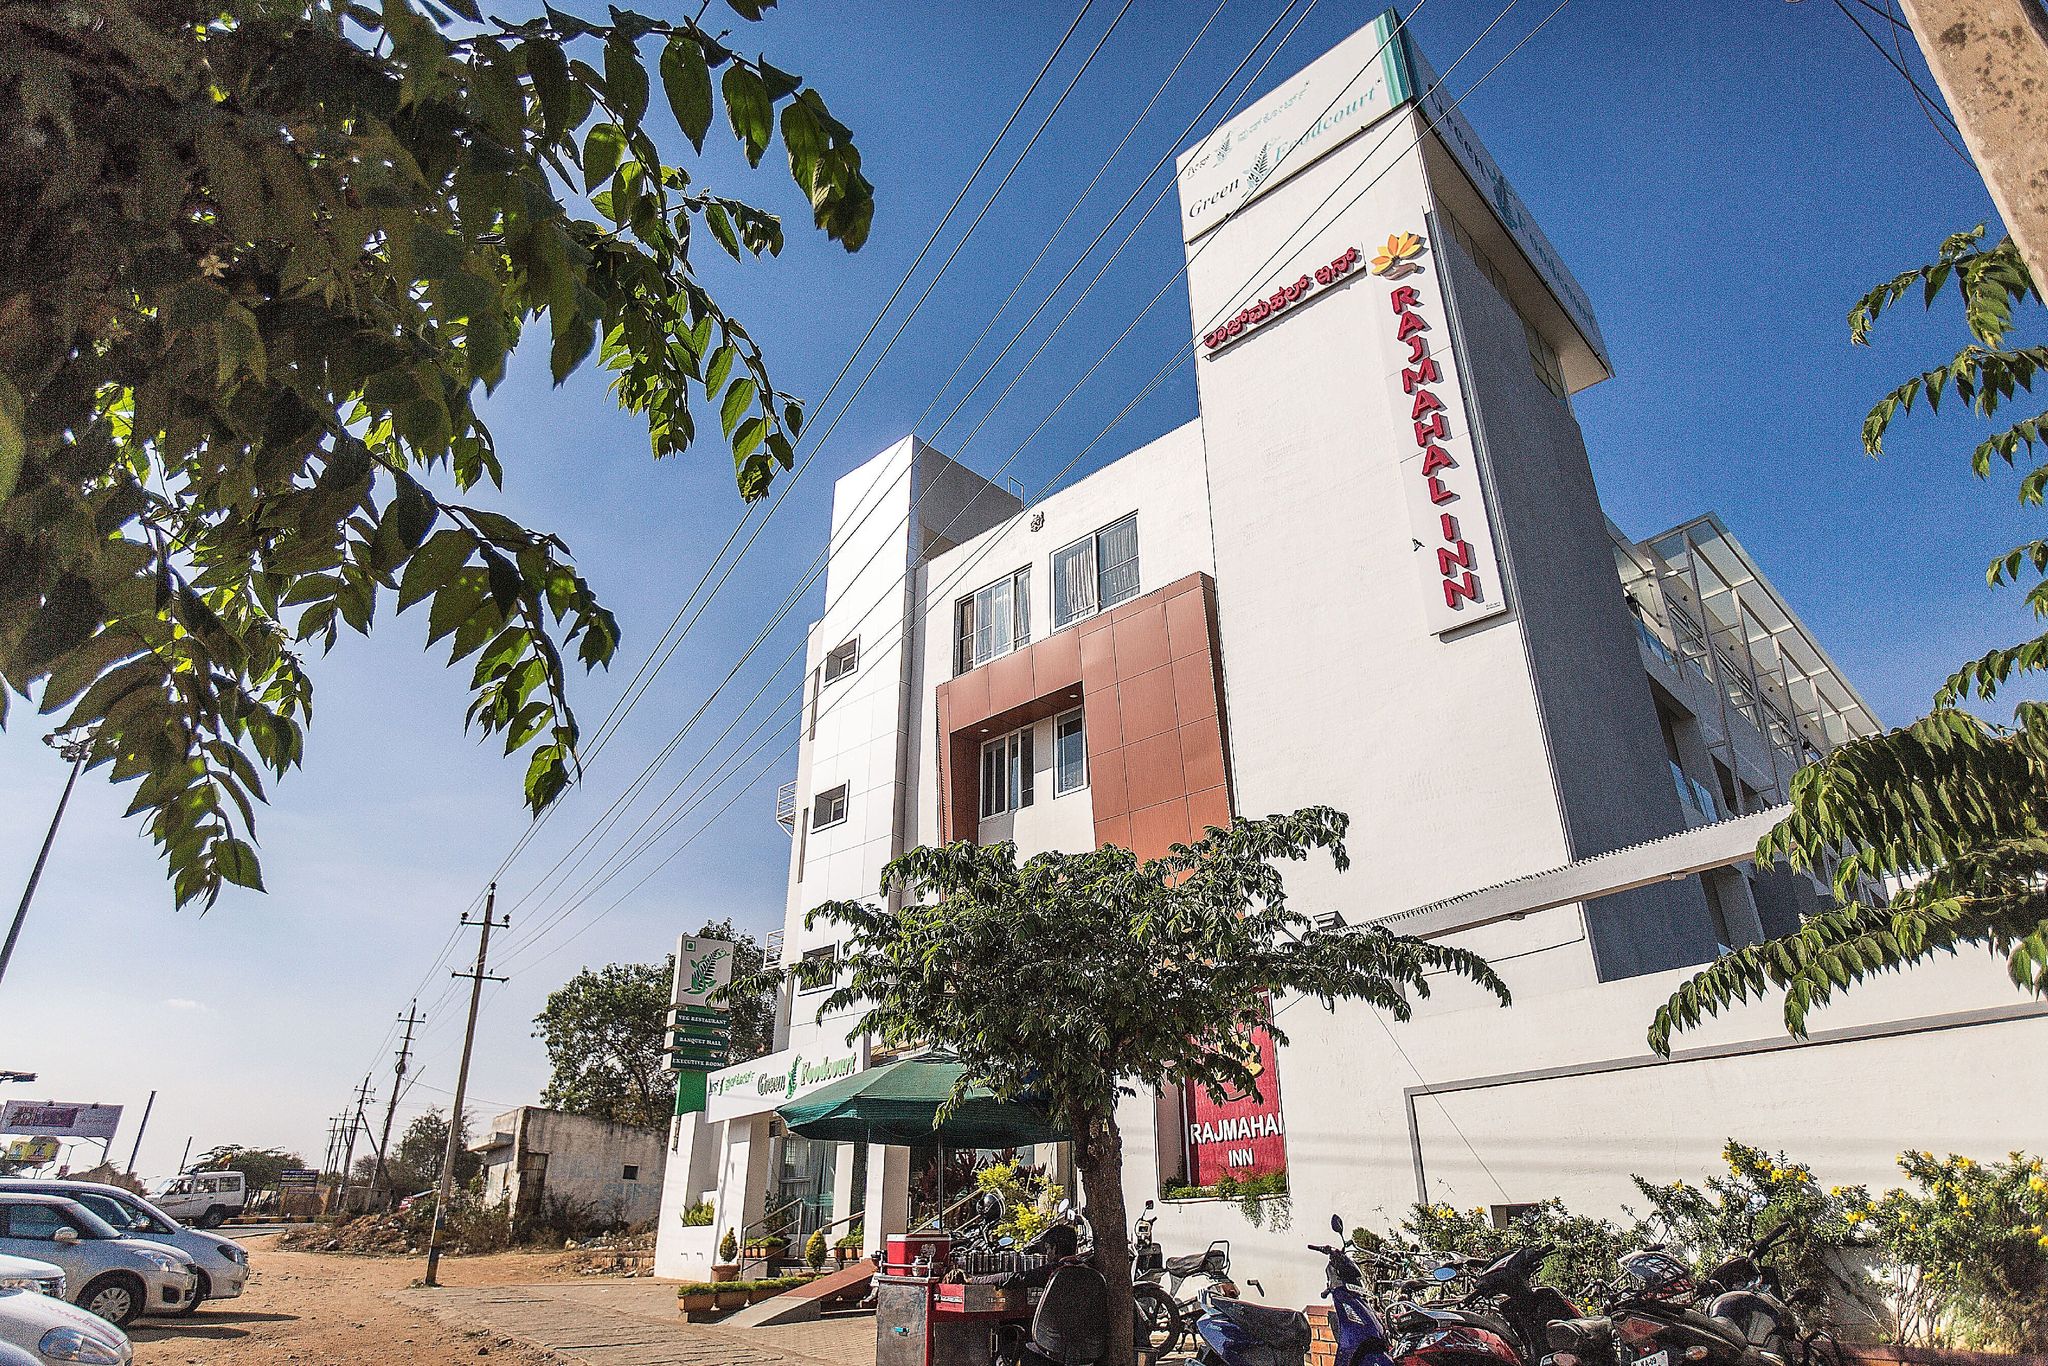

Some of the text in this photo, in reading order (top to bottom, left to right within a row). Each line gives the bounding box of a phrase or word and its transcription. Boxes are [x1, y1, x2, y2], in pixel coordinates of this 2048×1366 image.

[1189, 178, 1240, 218] Green
[1391, 285, 1476, 611] RAJMAHAL INN
[691, 1016, 727, 1025] RESTAURANT
[680, 1037, 706, 1045] BANQUET
[672, 1058, 705, 1066] EXECUTIVE
[757, 1072, 786, 1096] Green
[800, 1052, 856, 1087] Foodcourt
[1228, 1147, 1254, 1168] INN
